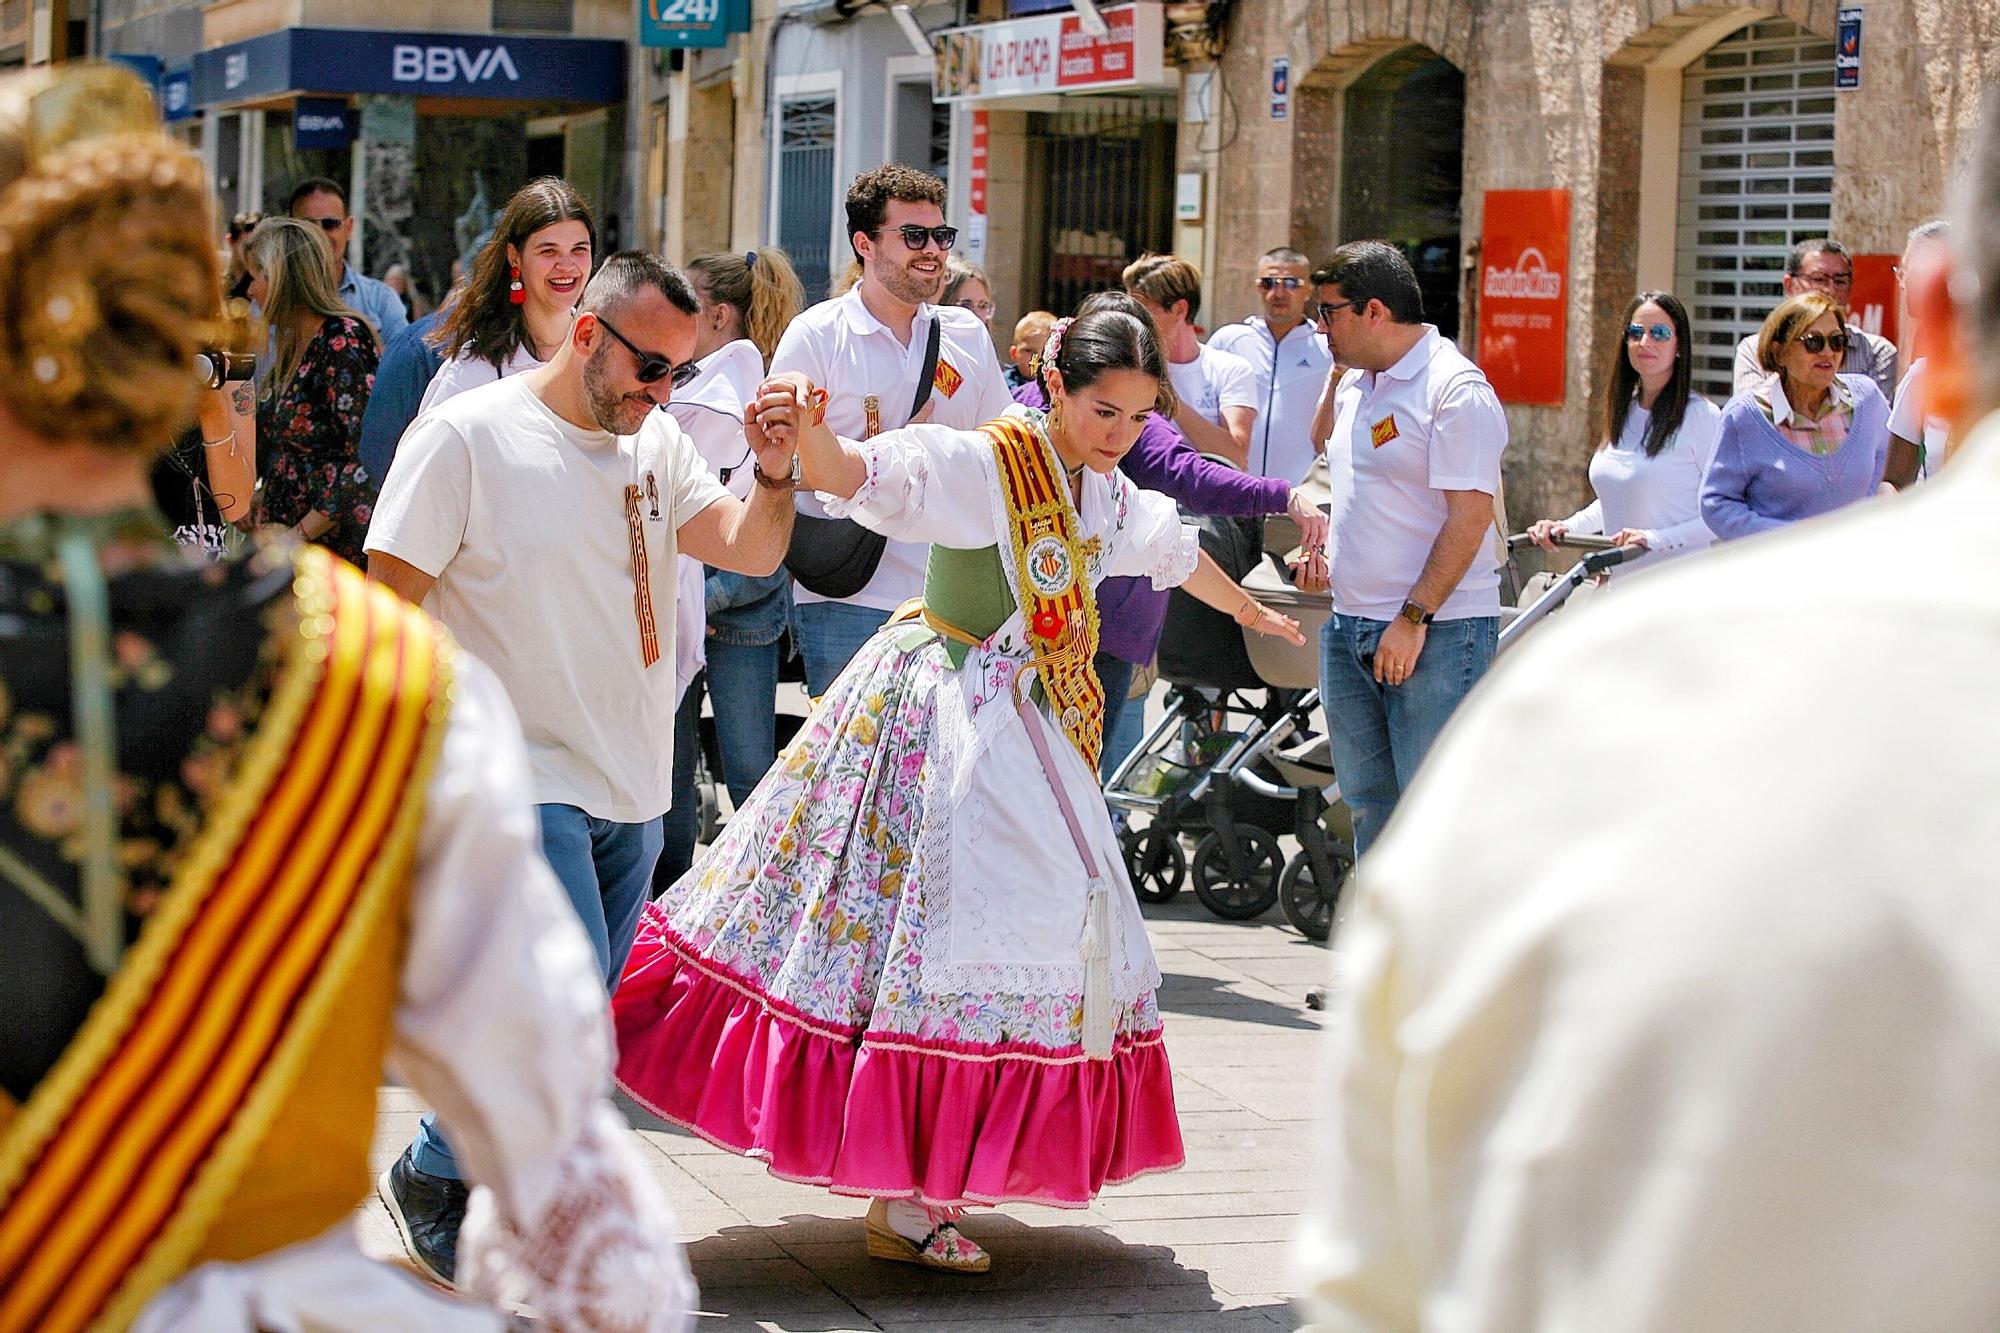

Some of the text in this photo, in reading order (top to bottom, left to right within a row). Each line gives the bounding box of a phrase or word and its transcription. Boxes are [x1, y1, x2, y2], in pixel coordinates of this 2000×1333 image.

[392, 45, 519, 83] BBVA
[987, 37, 1050, 85] LA PLAÇA
[299, 115, 344, 131] BBVA
